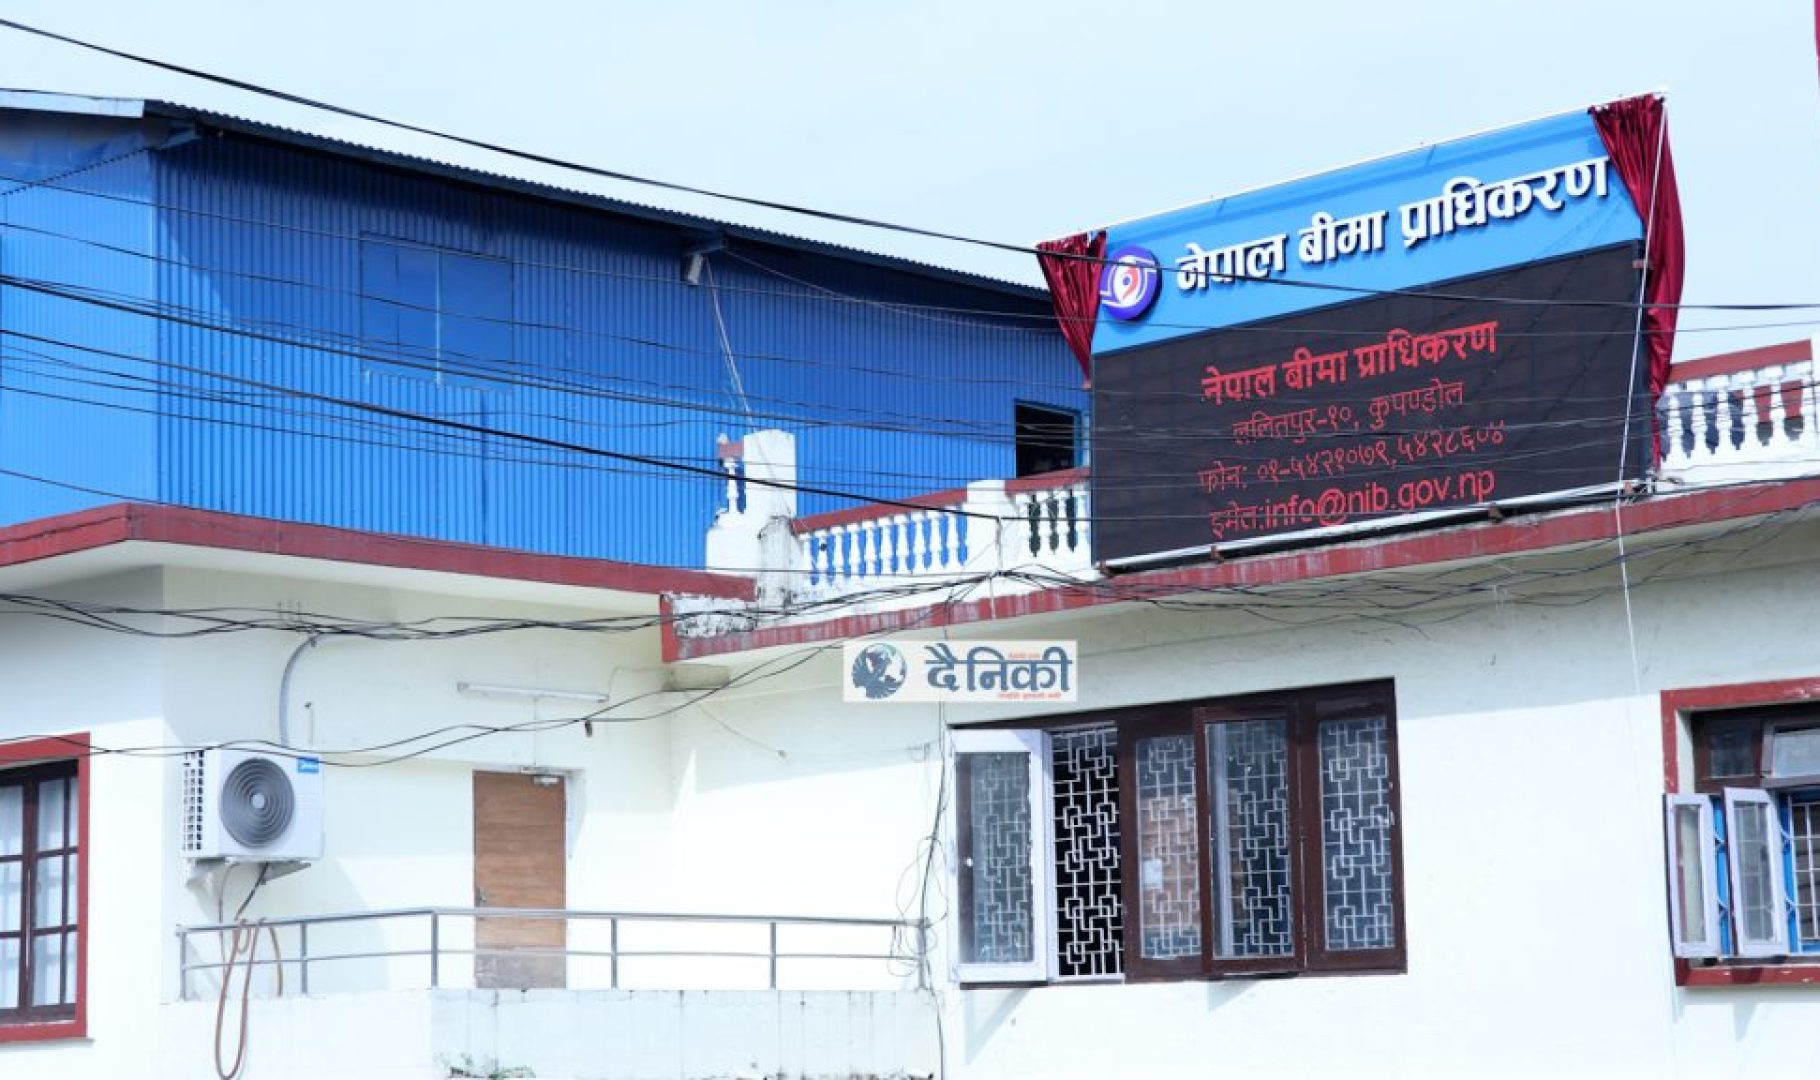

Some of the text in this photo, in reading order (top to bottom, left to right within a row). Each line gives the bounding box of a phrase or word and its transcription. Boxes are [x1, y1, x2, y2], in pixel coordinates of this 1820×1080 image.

[1175, 156, 1610, 290] नेपाल बीमा प्राधिकरण
[1201, 321, 1498, 405] नेपाल बीमा प्राधिकरण
[1232, 377, 1464, 444] ललितपुर-१०, कुपण्डोल
